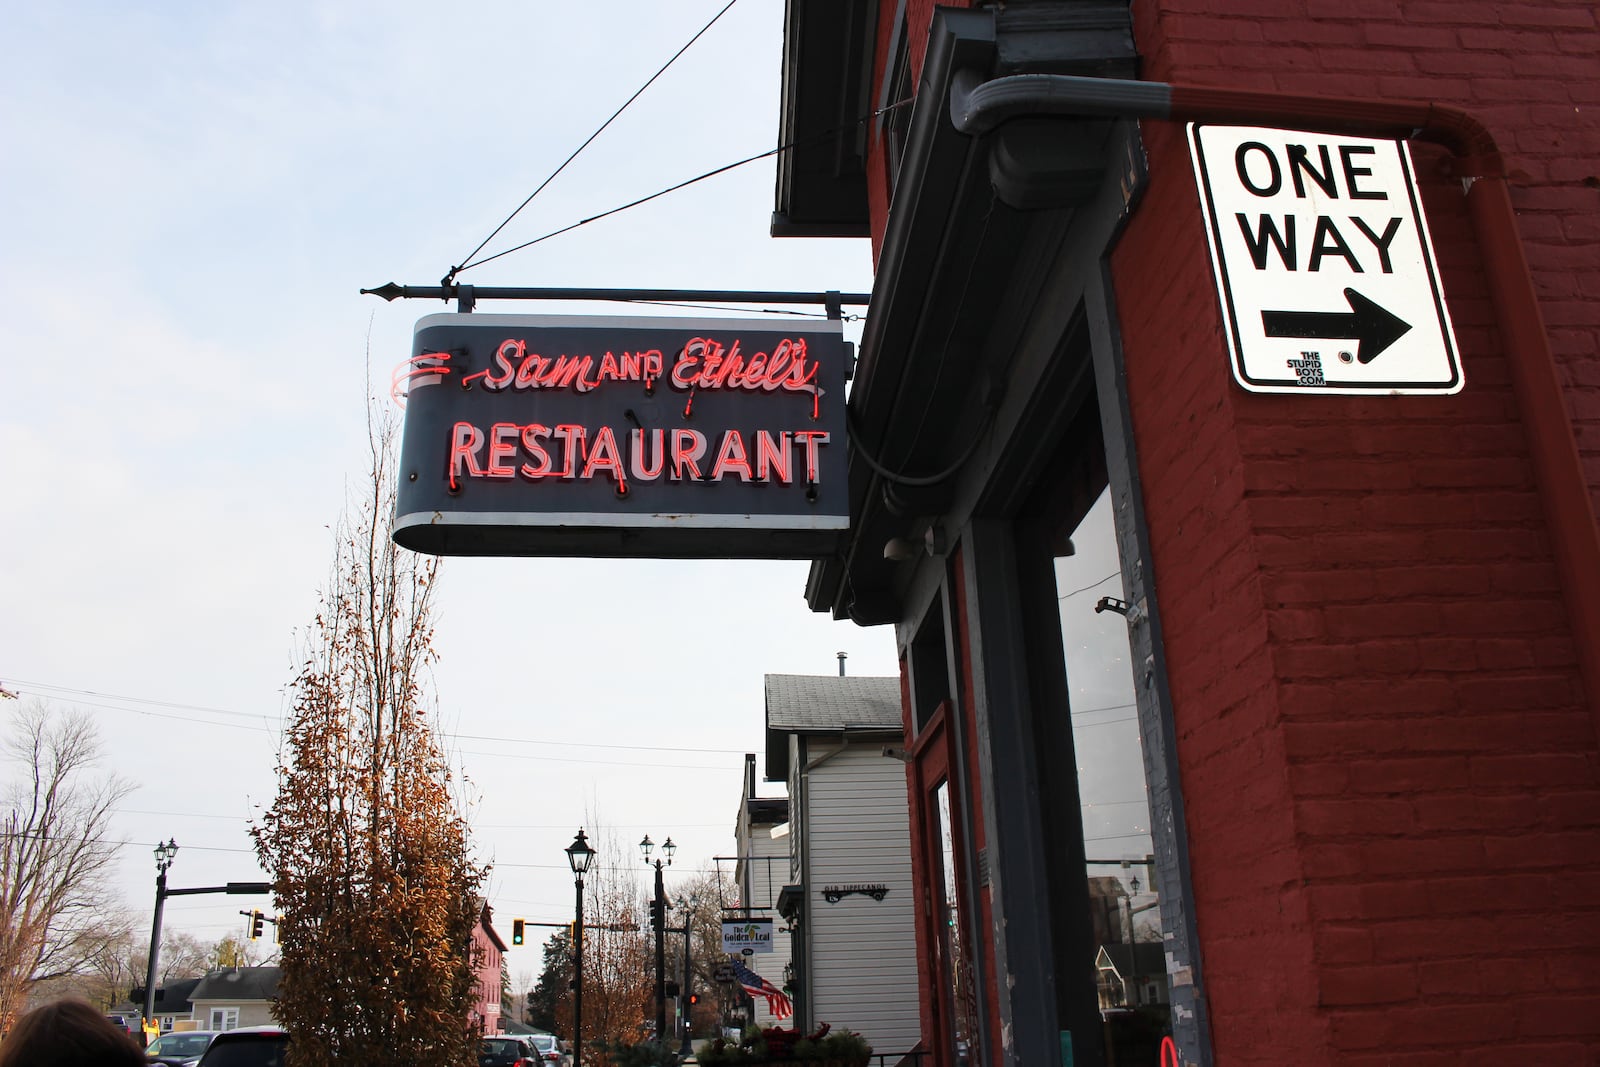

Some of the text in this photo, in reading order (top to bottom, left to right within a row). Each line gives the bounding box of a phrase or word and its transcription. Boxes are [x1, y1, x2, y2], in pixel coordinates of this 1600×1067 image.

[1235, 141, 1388, 200] ONE
[1235, 212, 1403, 274] WAY
[483, 337, 825, 395] Sam AND Ethel's
[1286, 359, 1322, 368] STUPID
[1295, 368, 1324, 376] BOYS
[1300, 351, 1320, 360] THE
[449, 421, 830, 486] RESTAURANT
[724, 933, 749, 941] Golden
